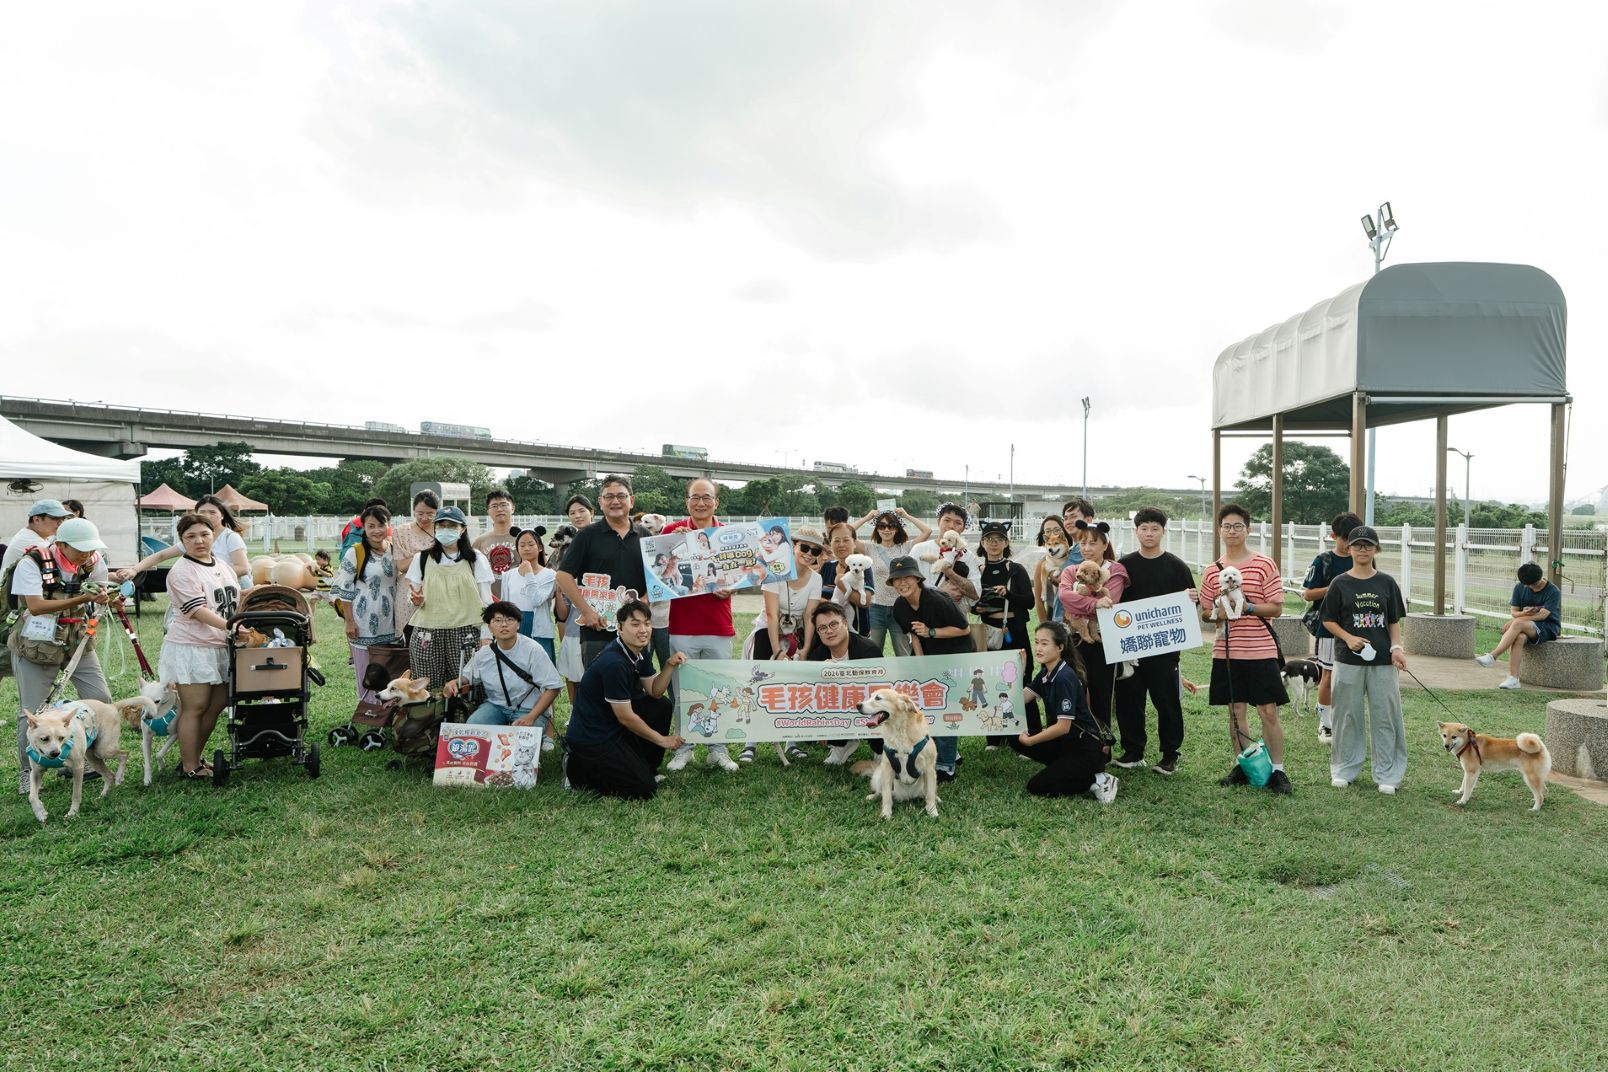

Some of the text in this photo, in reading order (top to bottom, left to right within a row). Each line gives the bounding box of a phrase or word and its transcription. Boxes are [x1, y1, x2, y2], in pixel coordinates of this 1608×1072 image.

[1135, 605, 1182, 622] unicharm
[1137, 617, 1183, 631] PET WELLNESS
[1120, 628, 1187, 654] 嬌聯寵物
[776, 718, 851, 729] #WorldRabiesDay
